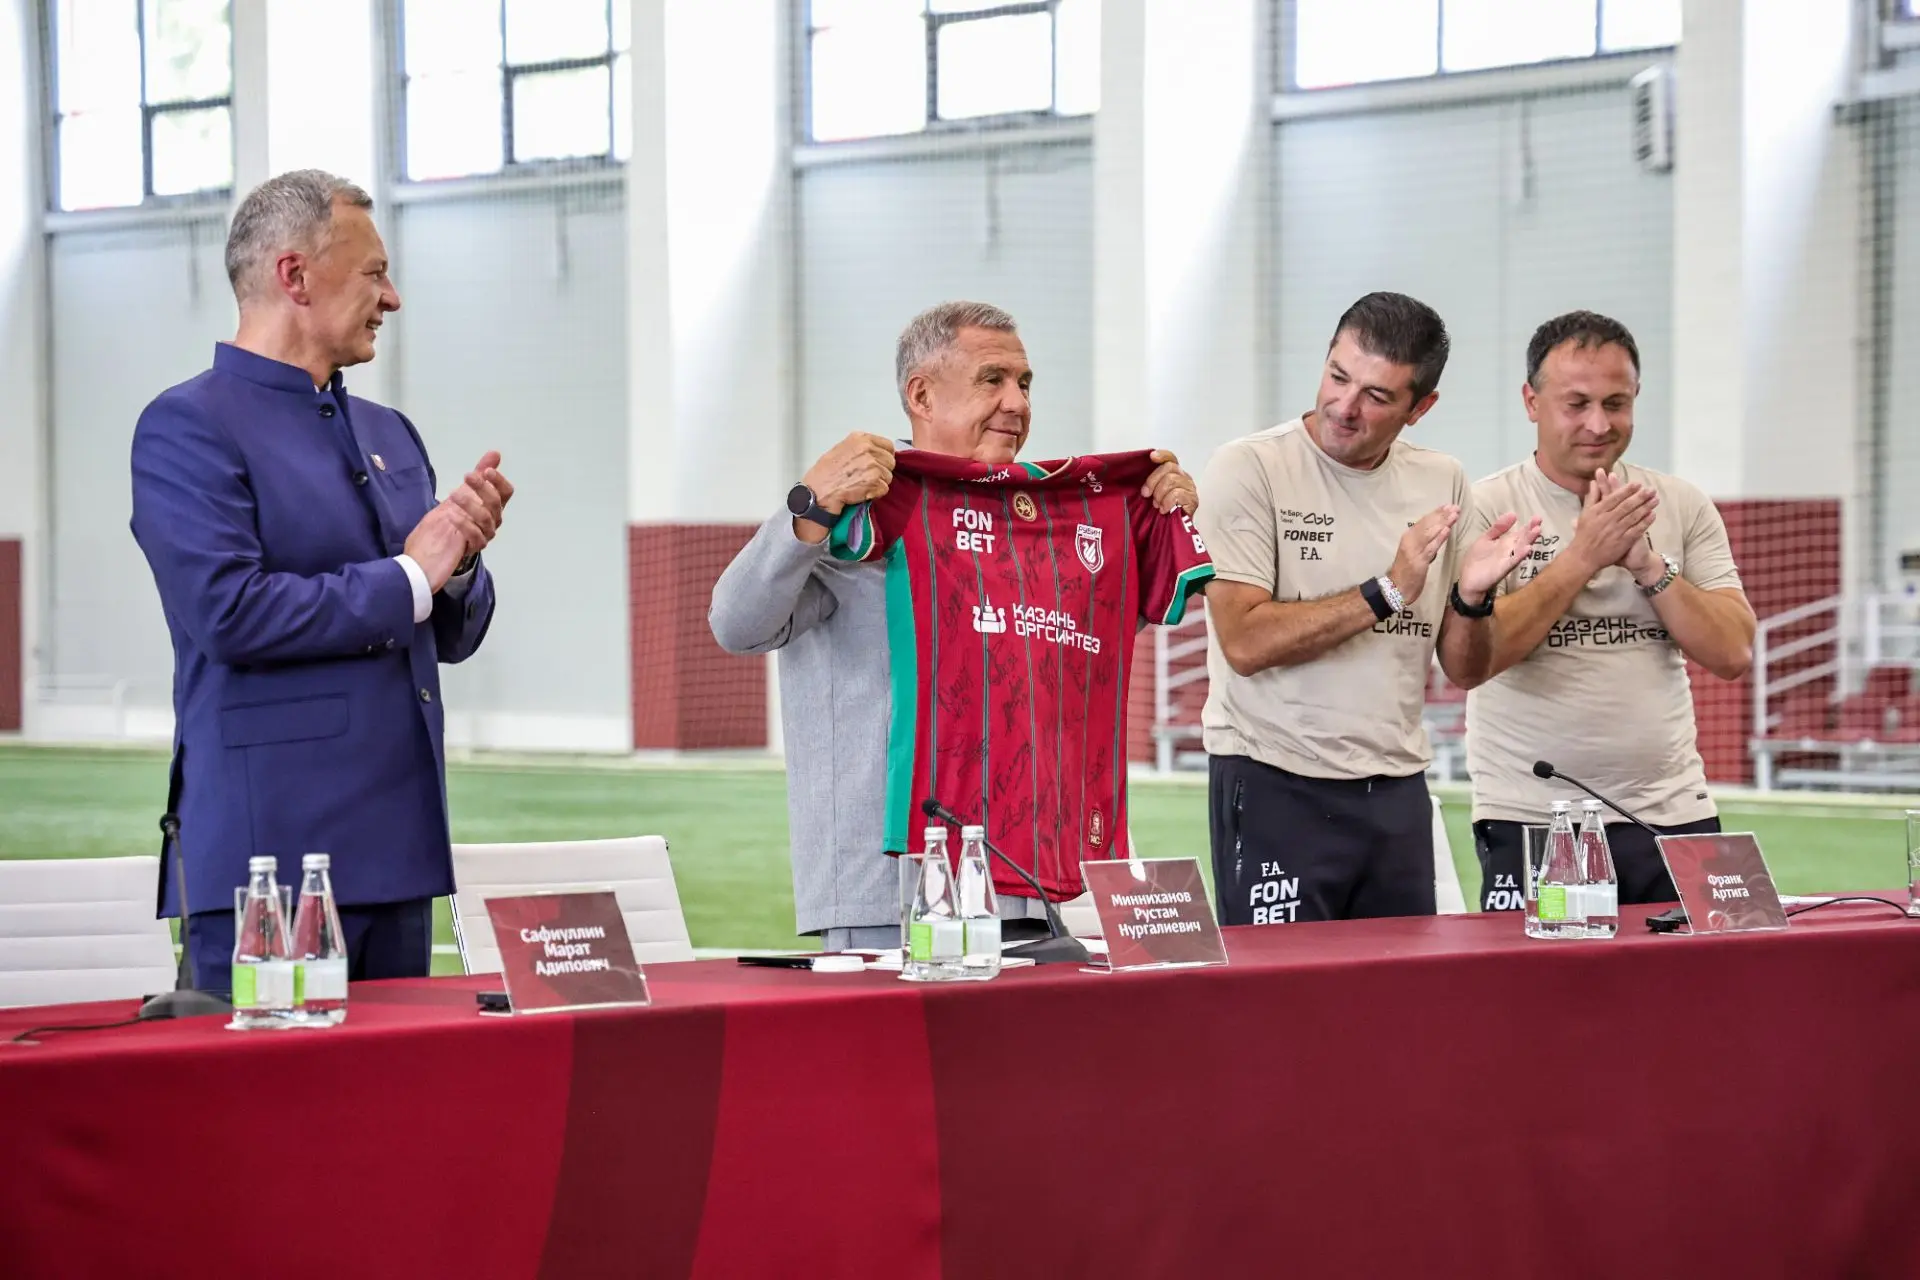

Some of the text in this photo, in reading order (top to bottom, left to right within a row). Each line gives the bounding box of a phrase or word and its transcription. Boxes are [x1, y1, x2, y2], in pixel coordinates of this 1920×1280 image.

[952, 508, 993, 531] FON
[955, 530, 996, 553] BET
[1283, 529, 1334, 543] FONBET
[1300, 546, 1323, 560] F.A.
[1012, 602, 1076, 631] КАЗАНЬ
[1014, 620, 1101, 655] ОРГСИНТЕЗ
[1260, 861, 1285, 877] F.A.
[1707, 874, 1744, 888] Франк
[1110, 891, 1192, 907] Минниханов
[1249, 877, 1300, 907] FON
[1485, 890, 1525, 911] FON
[1711, 887, 1750, 902] Артига
[1133, 907, 1179, 923] Рустам
[1253, 900, 1301, 926] BET
[520, 925, 606, 944] Сафиуллин
[1118, 921, 1201, 940] Нургалиевич
[543, 942, 591, 960] Марат
[535, 958, 610, 977] Адипович
